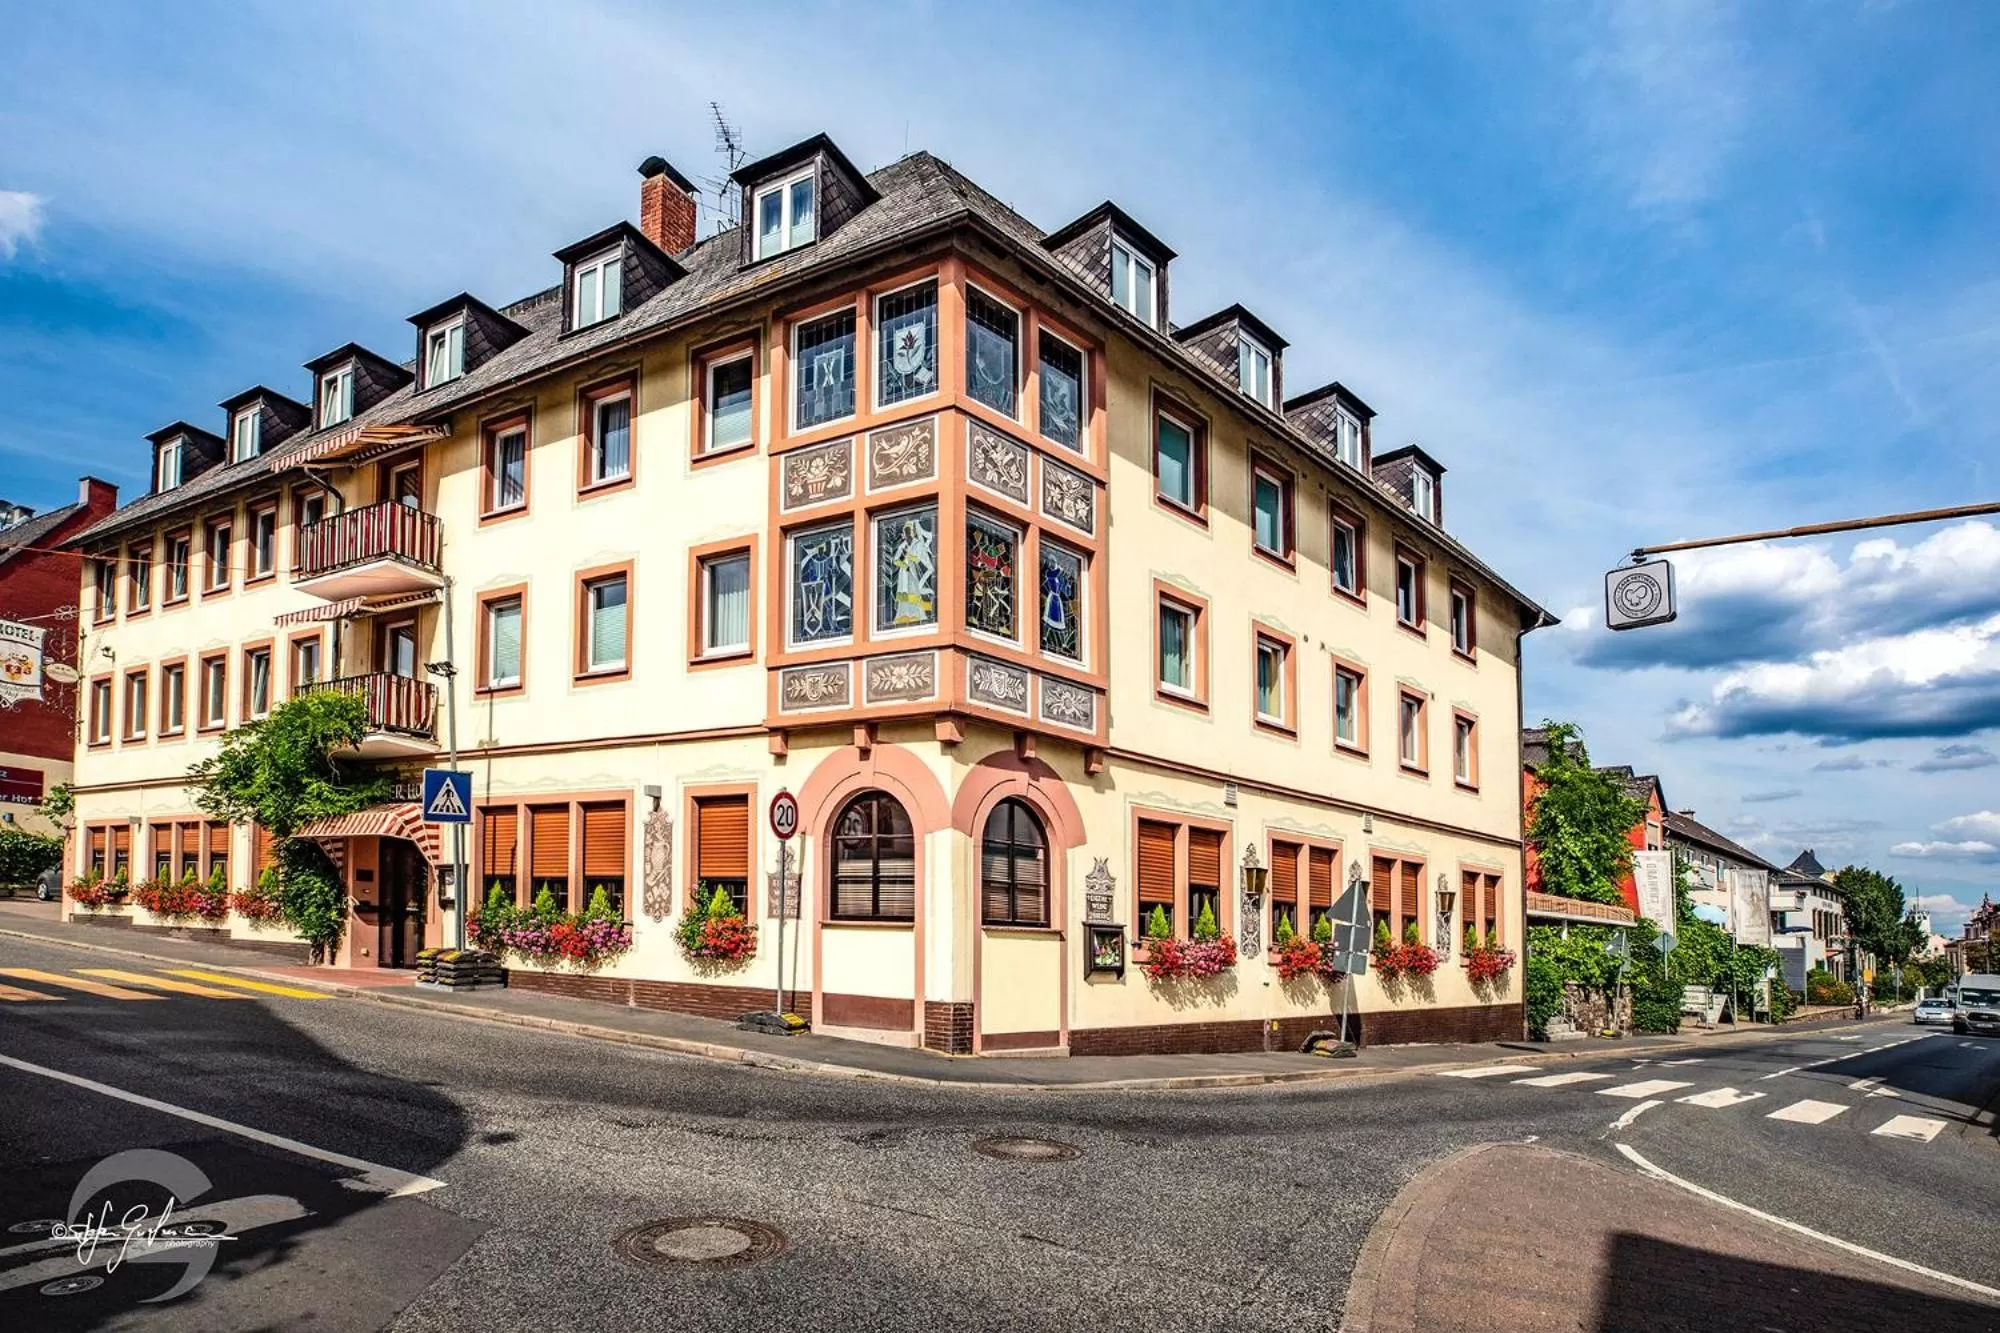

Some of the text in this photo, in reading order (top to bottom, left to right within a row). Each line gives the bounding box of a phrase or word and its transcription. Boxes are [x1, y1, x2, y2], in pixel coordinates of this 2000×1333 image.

[11, 794, 33, 804] Hof
[407, 783, 423, 800] HO
[776, 804, 794, 827] 20
